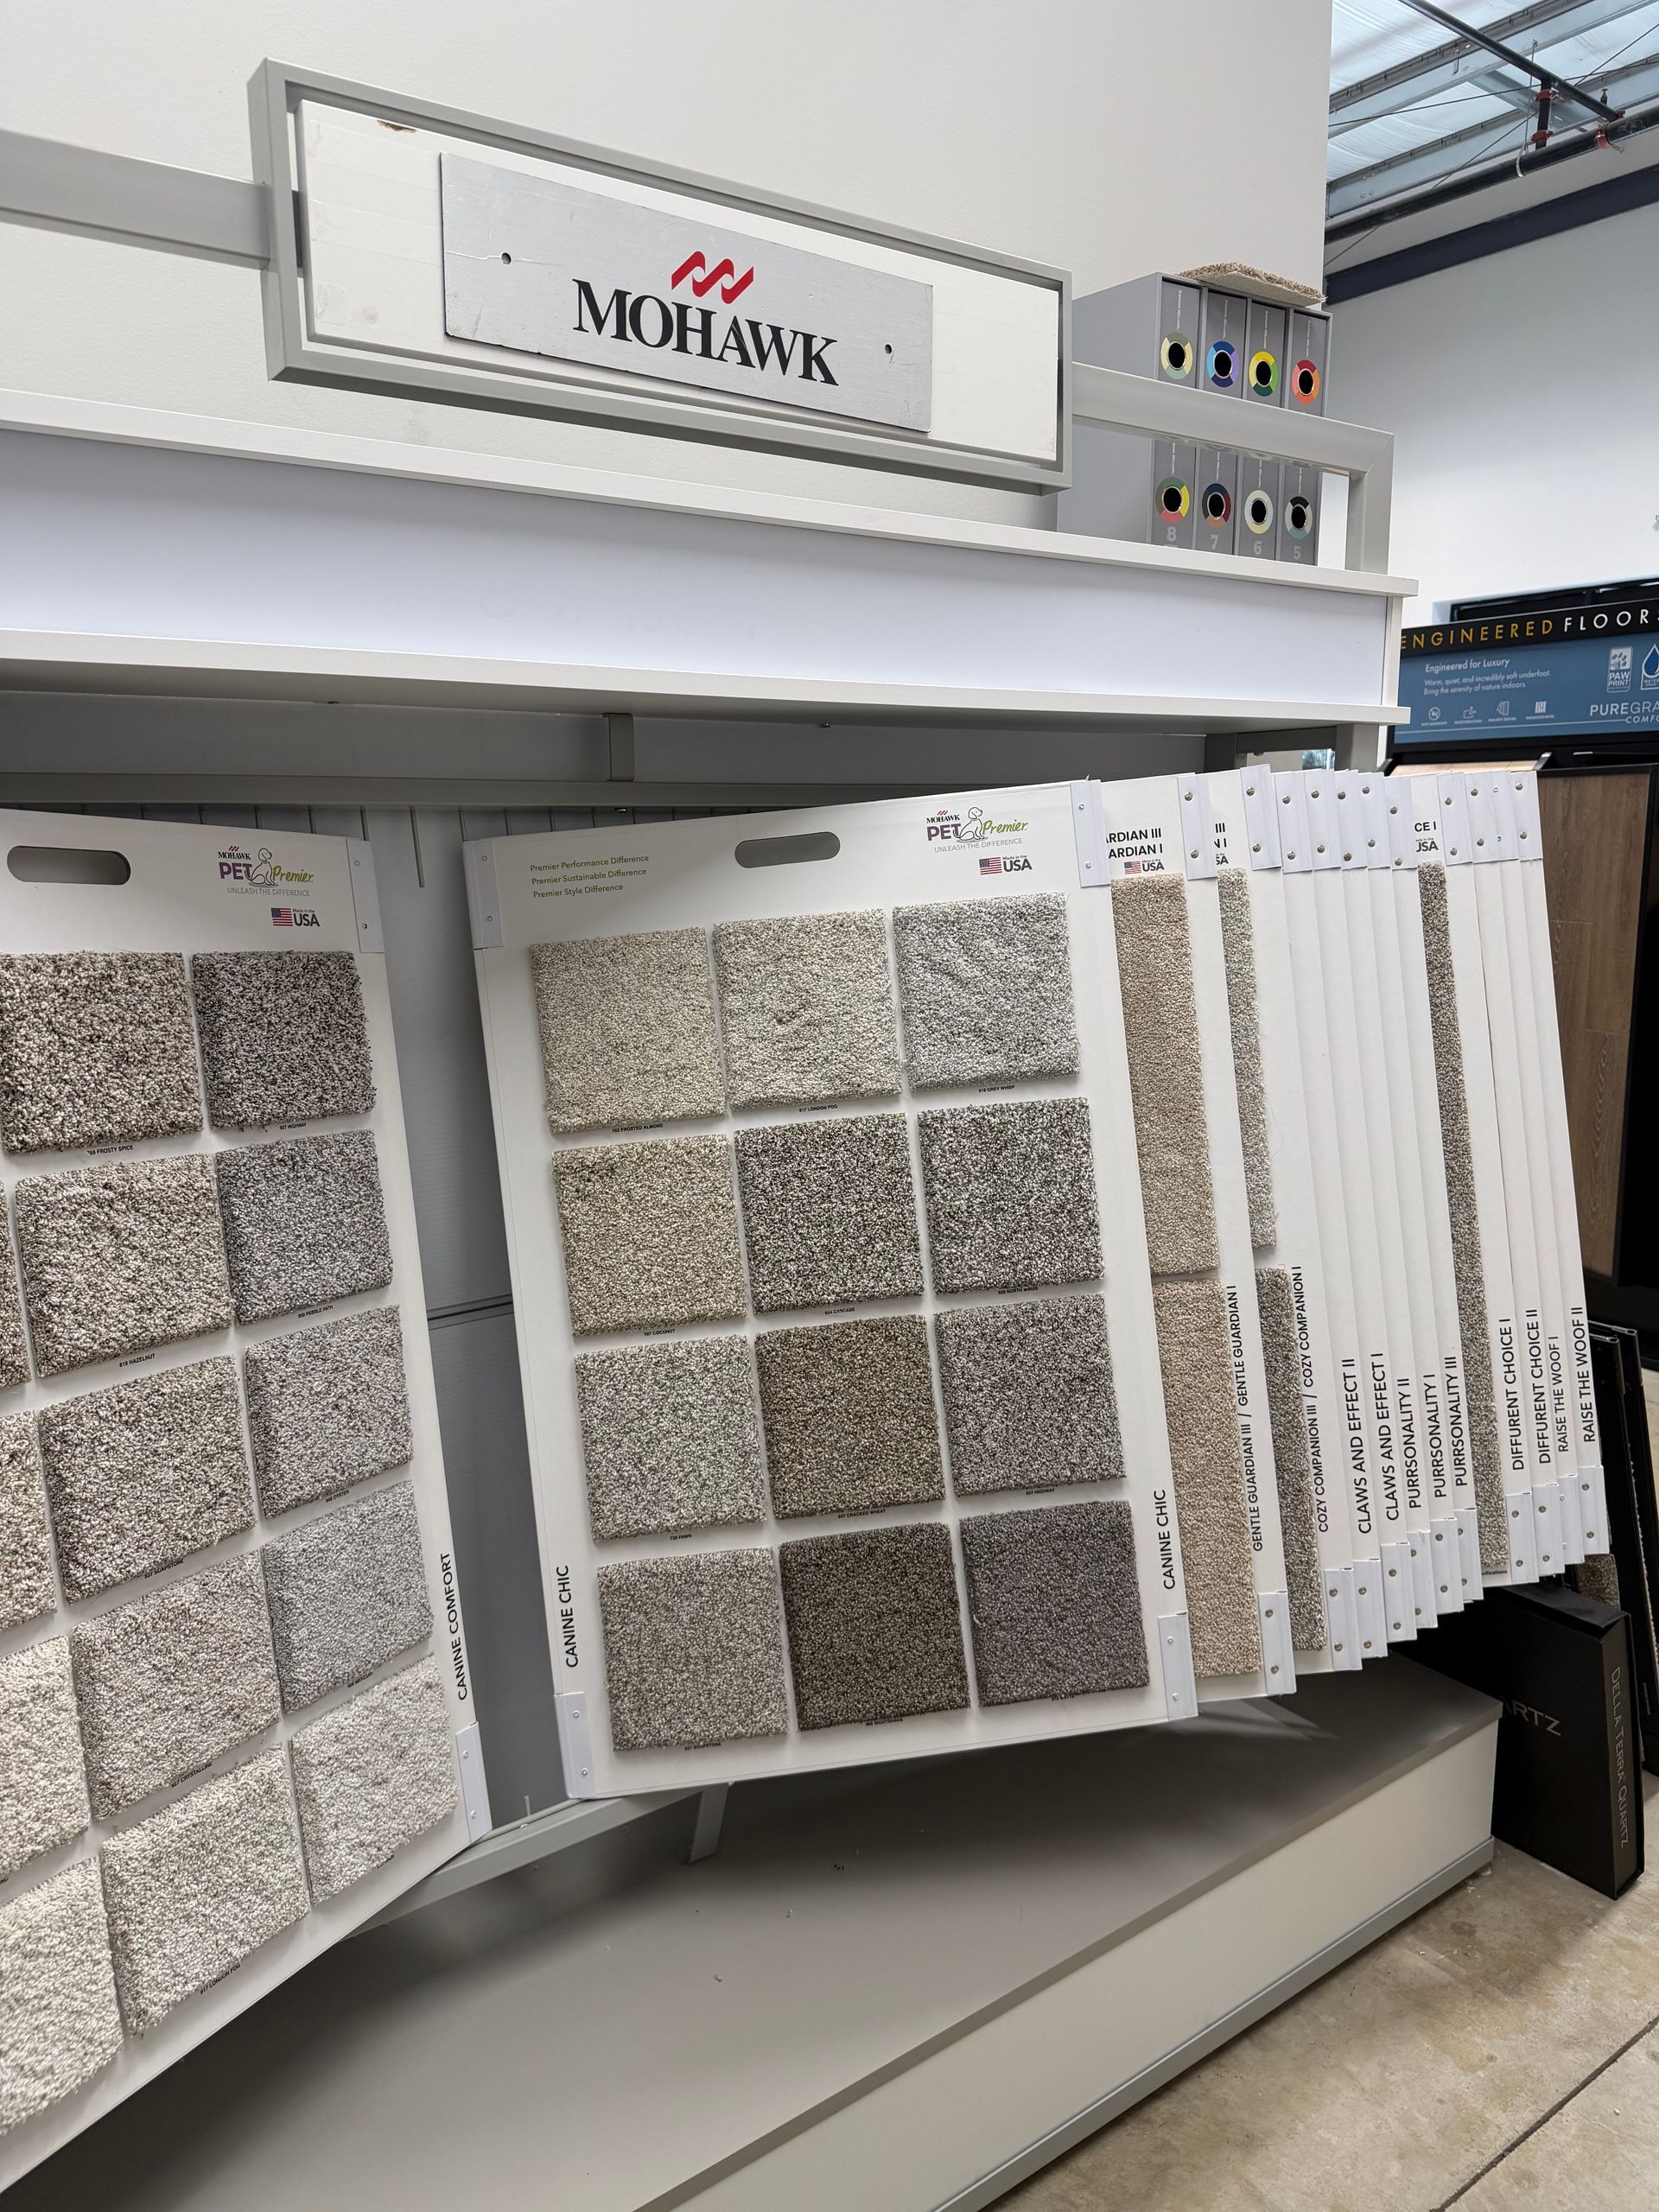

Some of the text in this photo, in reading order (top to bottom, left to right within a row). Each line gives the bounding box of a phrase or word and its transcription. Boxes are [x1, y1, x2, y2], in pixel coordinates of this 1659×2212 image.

[572, 278, 839, 386] MOHAWK
[1166, 526, 1177, 542] 8
[1210, 535, 1219, 550] 7
[1254, 540, 1262, 555] 6
[1293, 545, 1301, 560] 5
[1401, 608, 1659, 649] ENGINEERED FLOOR
[1425, 658, 1510, 674] Engineered for Luxury
[1462, 675, 1474, 683] and
[1475, 672, 1505, 683] incredibly
[1506, 671, 1518, 680] soft
[1609, 671, 1630, 681] PAW
[1423, 688, 1439, 696] Bring
[1440, 686, 1449, 695] the
[1450, 684, 1471, 694] serenity
[1481, 683, 1500, 691] nature
[926, 814, 960, 823] MOHAWK
[926, 819, 1028, 841] PET Premier
[1151, 828, 1162, 839] III
[218, 850, 251, 861] MOHAWK
[934, 843, 966, 853] UNLEASH
[982, 838, 1023, 849] DIFFERENCE
[1159, 843, 1163, 853] I
[219, 861, 315, 883] PET Premier
[531, 855, 649, 872] Premier Performance Difference
[531, 868, 647, 885] Premier Sustainable Difference
[1003, 859, 1033, 873] USA
[1141, 861, 1165, 872] USA
[227, 887, 310, 897] UNLEASH THE DIFFERENCE
[533, 884, 624, 898] Premier Style Difference
[294, 913, 321, 927] USA
[1227, 1294, 1243, 1358] GUARDIAN
[1293, 1273, 1310, 1351] COMPANION
[129, 1353, 156, 1365] HAZELNUT
[1499, 1325, 1517, 1385] CHOICE
[1527, 1320, 1544, 1379] CHOICE
[1548, 1343, 1563, 1386] WOOF
[1234, 1360, 1249, 1407] GENTLE
[1300, 1353, 1313, 1388] COZY
[1571, 1306, 1596, 1442] RAISE THE WOOF II
[1371, 1361, 1390, 1420] EFFECT
[1553, 1388, 1566, 1414] THE
[1306, 1404, 1317, 1414] III
[1444, 1356, 1468, 1487] PURRSONALITY III
[1532, 1382, 1551, 1464] DIFFURENT
[1240, 1424, 1251, 1435] III
[1342, 1358, 1372, 1535] CLAWS AND EFFECT II
[1378, 1424, 1394, 1460] AND
[1396, 1377, 1421, 1509] PURRSONALITY II
[1423, 1382, 1446, 1498] PURRSONALITY
[1505, 1389, 1525, 1471] DIFFURENT
[1555, 1416, 1569, 1452] RAISE
[1242, 1438, 1258, 1503] GUARDIAN
[1307, 1417, 1325, 1496] COMPANION
[1383, 1465, 1400, 1521] CLAWS
[1248, 1505, 1263, 1552] GENTLE
[1314, 1497, 1329, 1533] COZY
[1154, 1489, 1175, 1590] CANINE CHIC
[441, 1553, 467, 1700] CANINE COMFORT
[556, 1565, 579, 1668] CANINE CHIC
[1611, 1666, 1629, 1849] DELLA TERRA QUARTZ
